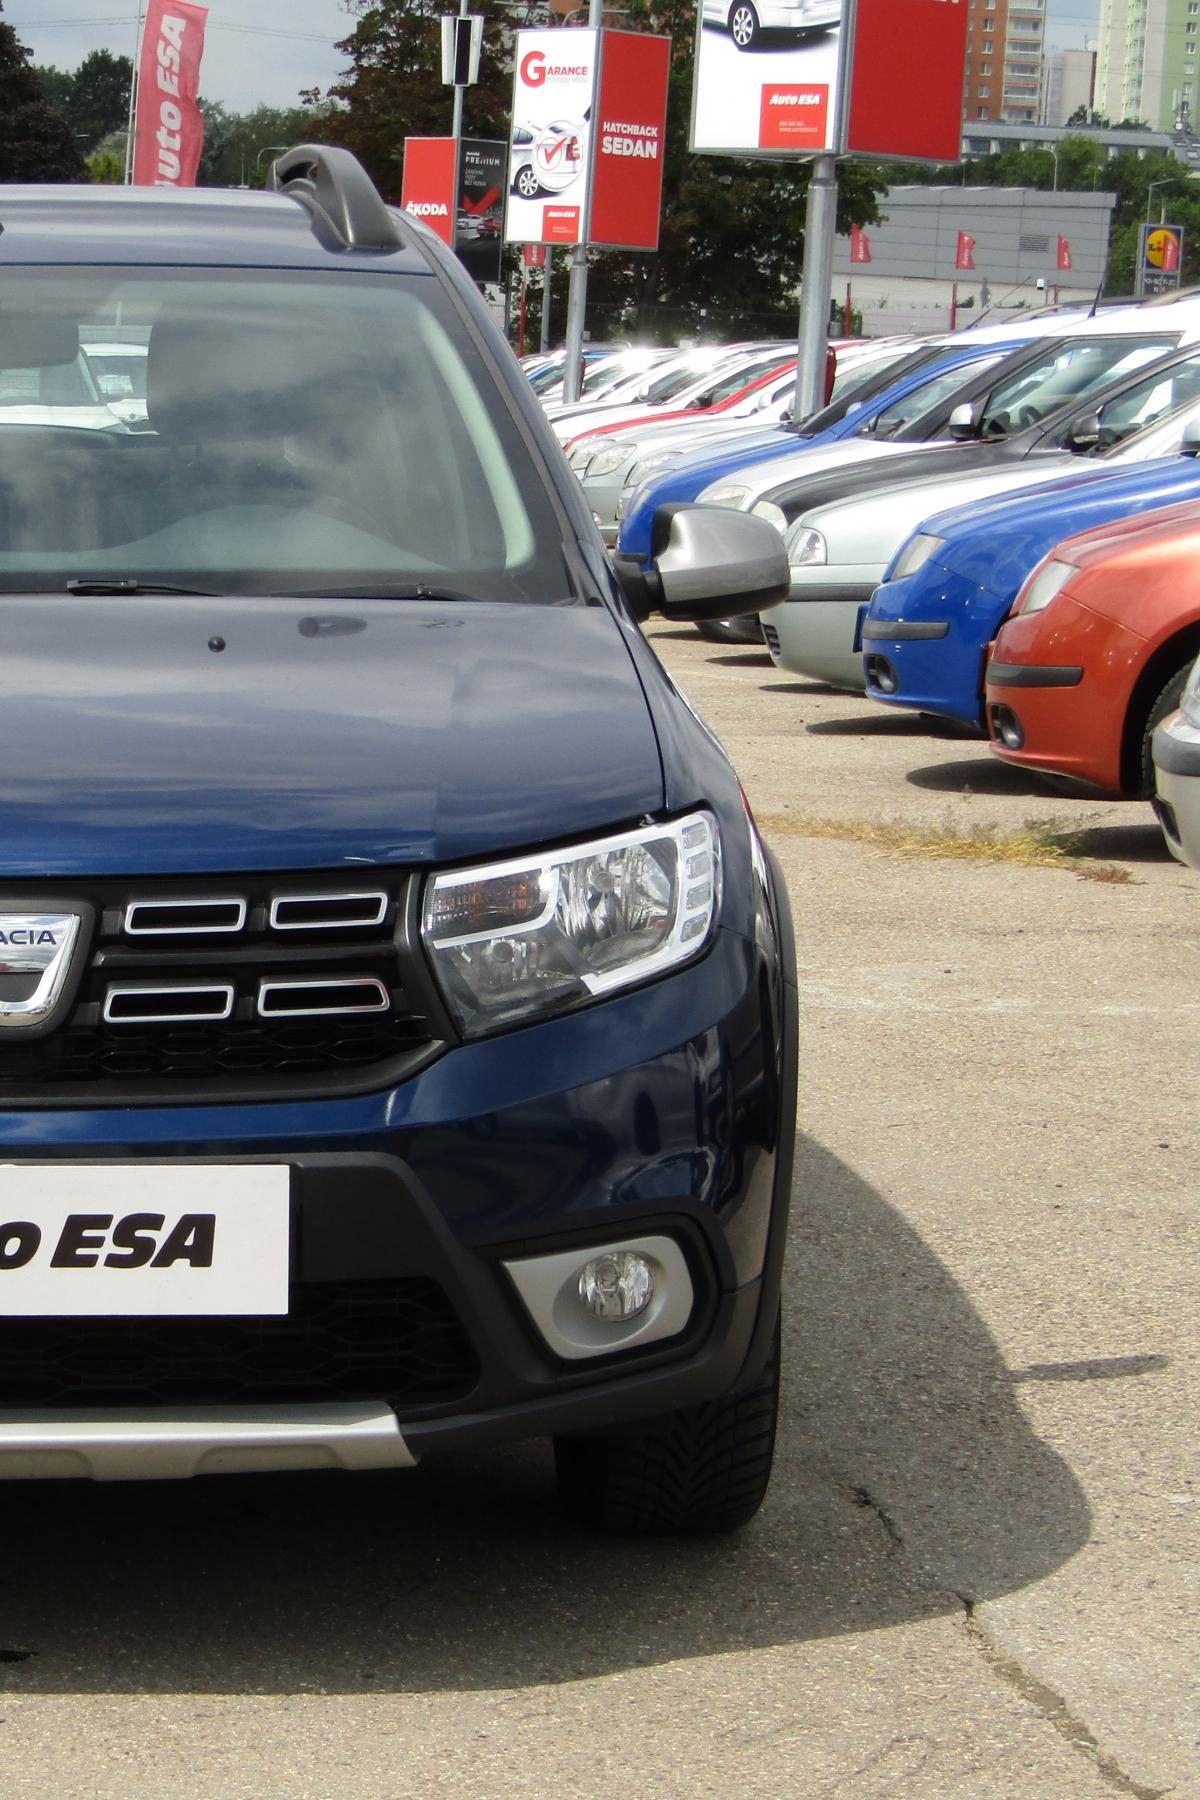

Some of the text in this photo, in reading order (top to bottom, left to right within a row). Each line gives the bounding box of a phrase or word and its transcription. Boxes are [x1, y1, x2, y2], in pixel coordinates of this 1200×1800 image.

[520, 50, 588, 88] GARANCE
[155, 14, 187, 187] uto ESA
[769, 94, 820, 105] Auto ESA
[603, 121, 658, 138] HATCHBACK
[601, 135, 658, 159] SEDAN
[405, 200, 448, 216] ŠKODA
[50, 1213, 216, 1269] ESA
